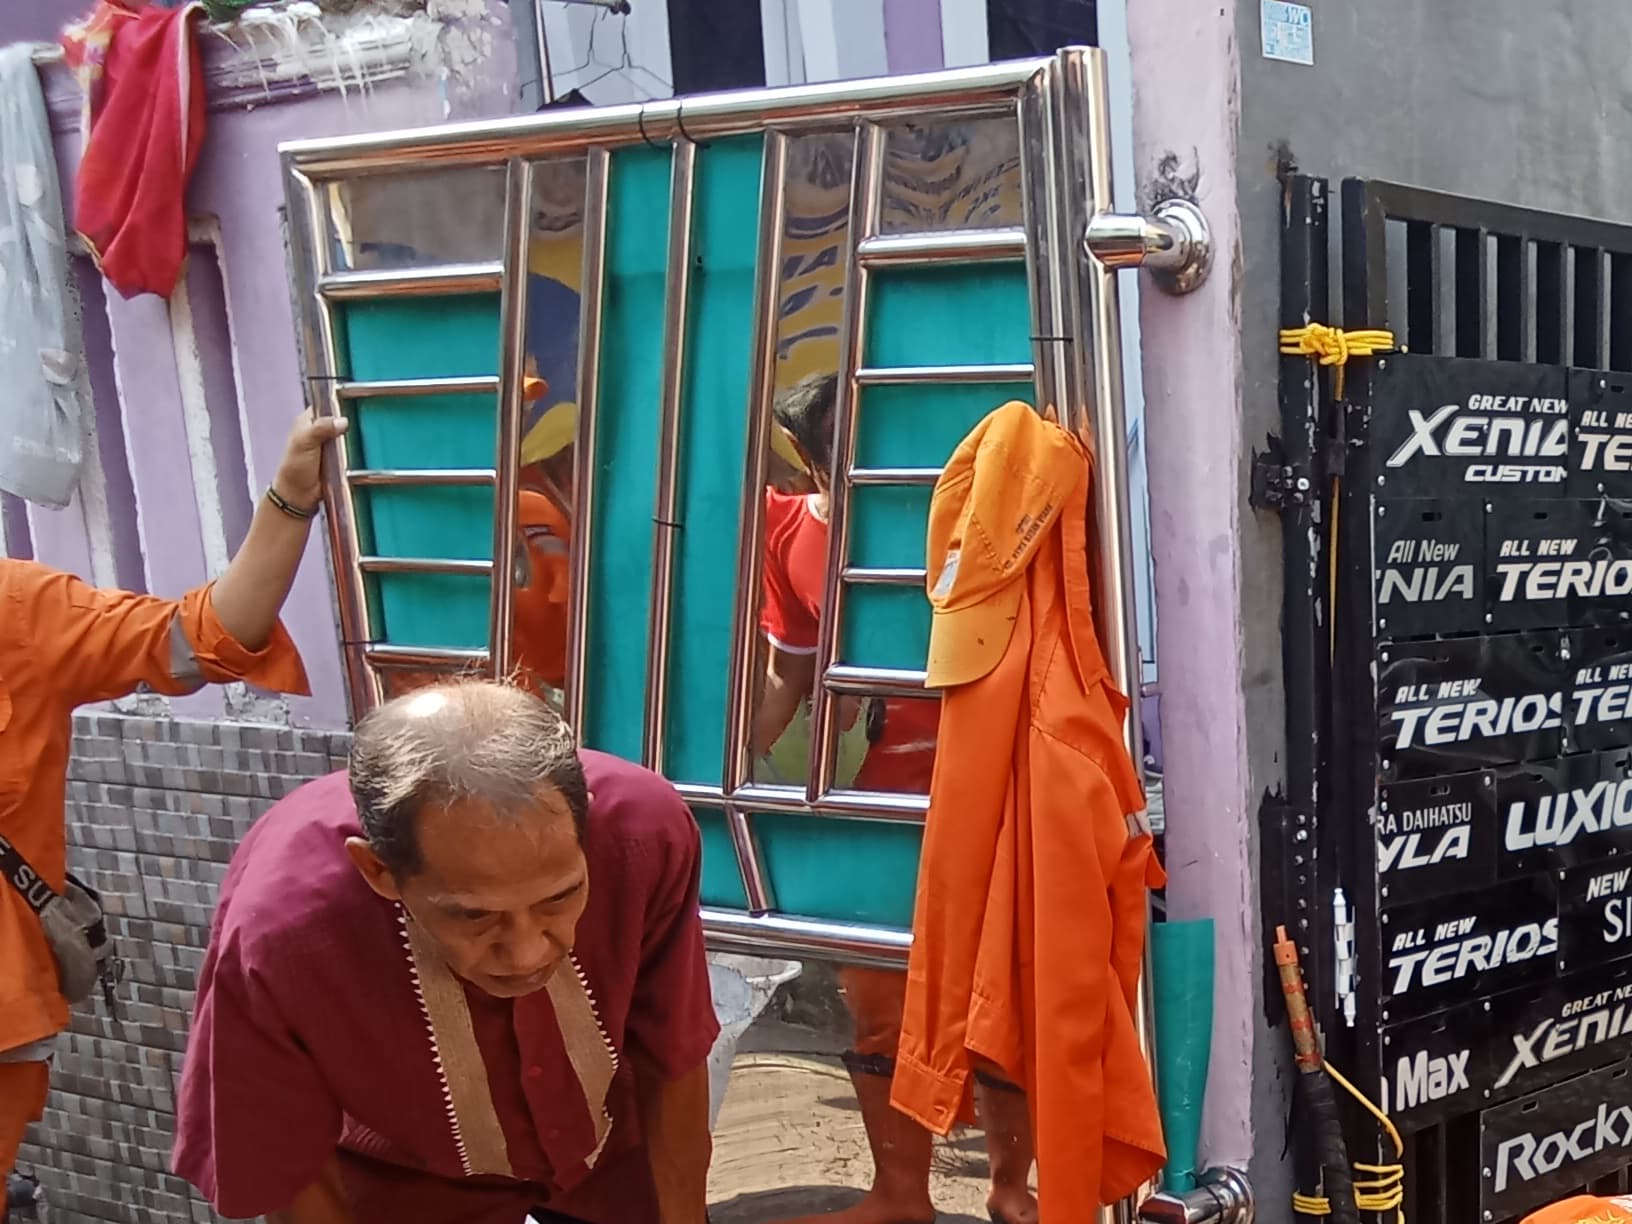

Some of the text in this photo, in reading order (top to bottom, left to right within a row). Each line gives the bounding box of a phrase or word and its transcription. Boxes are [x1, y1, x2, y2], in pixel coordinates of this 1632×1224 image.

[1468, 394, 1568, 414] GREAT NEW
[1580, 410, 1608, 427] ALL
[1386, 405, 1568, 467] XENIA
[1387, 539, 1460, 563] All New
[1500, 539, 1578, 557] ALL NEW
[1395, 678, 1482, 704] ALL NEW
[1575, 667, 1602, 686] ALL
[1403, 802, 1472, 832] DAIHATSU
[1586, 867, 1632, 902] NEW
[1392, 916, 1477, 952] ALL NEW
[1388, 917, 1558, 996] TERIOS
[1561, 989, 1612, 1018] GREAT
[1396, 1049, 1471, 1112] Max
